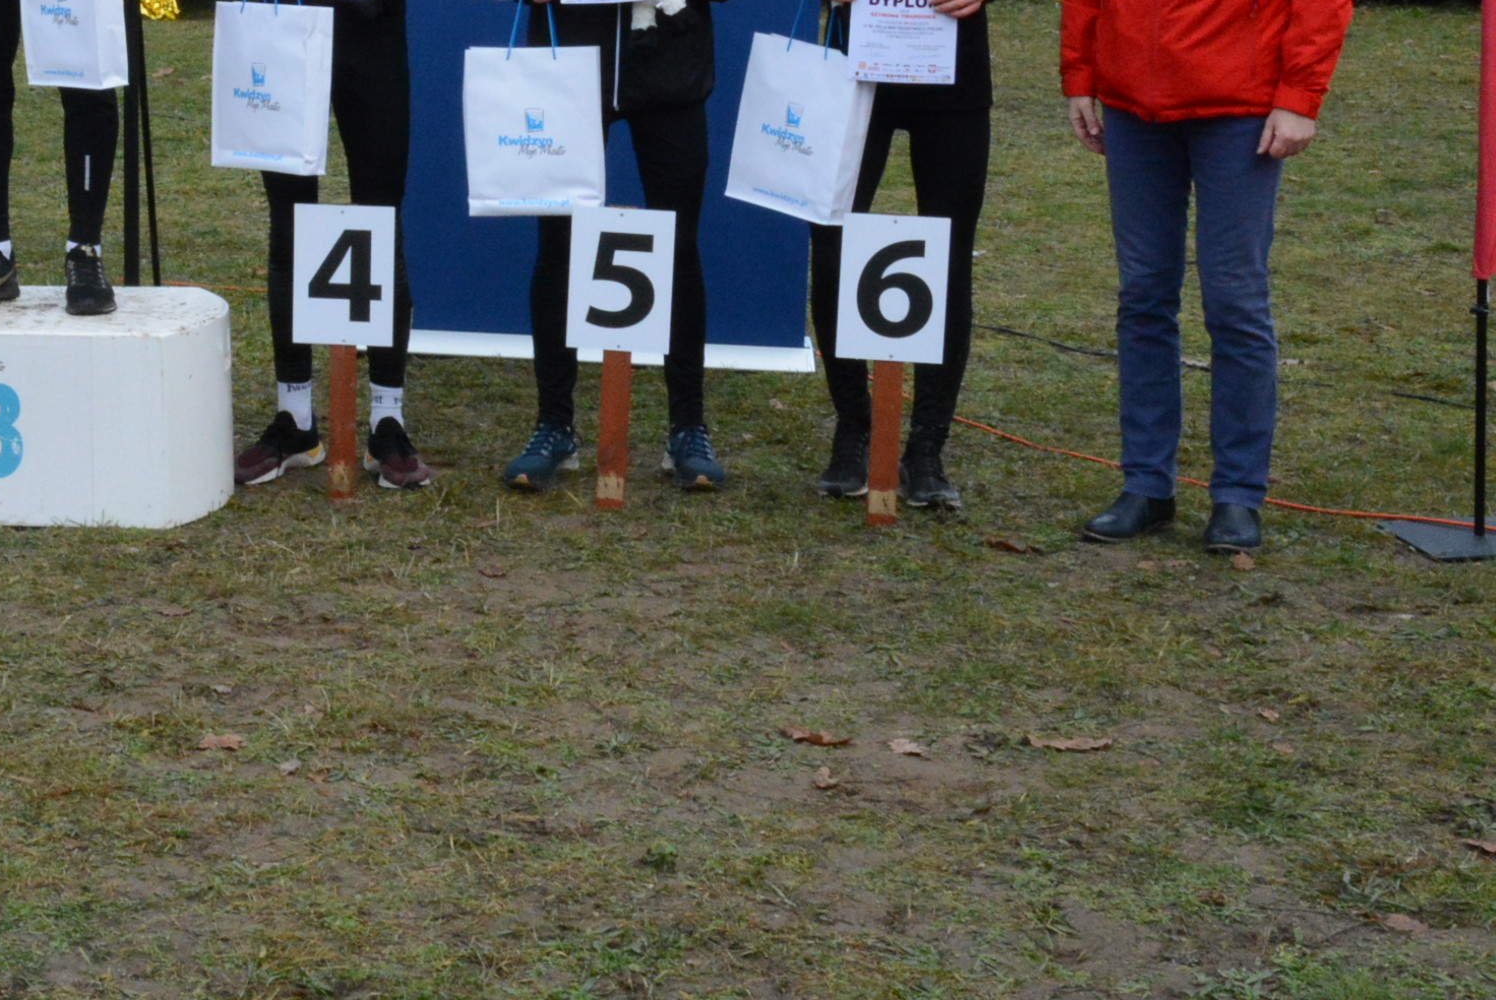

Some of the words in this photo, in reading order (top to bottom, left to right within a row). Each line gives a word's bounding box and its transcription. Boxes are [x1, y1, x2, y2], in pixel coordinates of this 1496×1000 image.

[41, 5, 72, 17] Kwidzyn
[233, 88, 271, 103] Kwidzyn
[498, 135, 553, 148] Kwidzyn
[761, 122, 805, 145] Kwidzyn
[308, 229, 382, 322] 4
[585, 231, 655, 329] 5
[856, 239, 933, 338] 6
